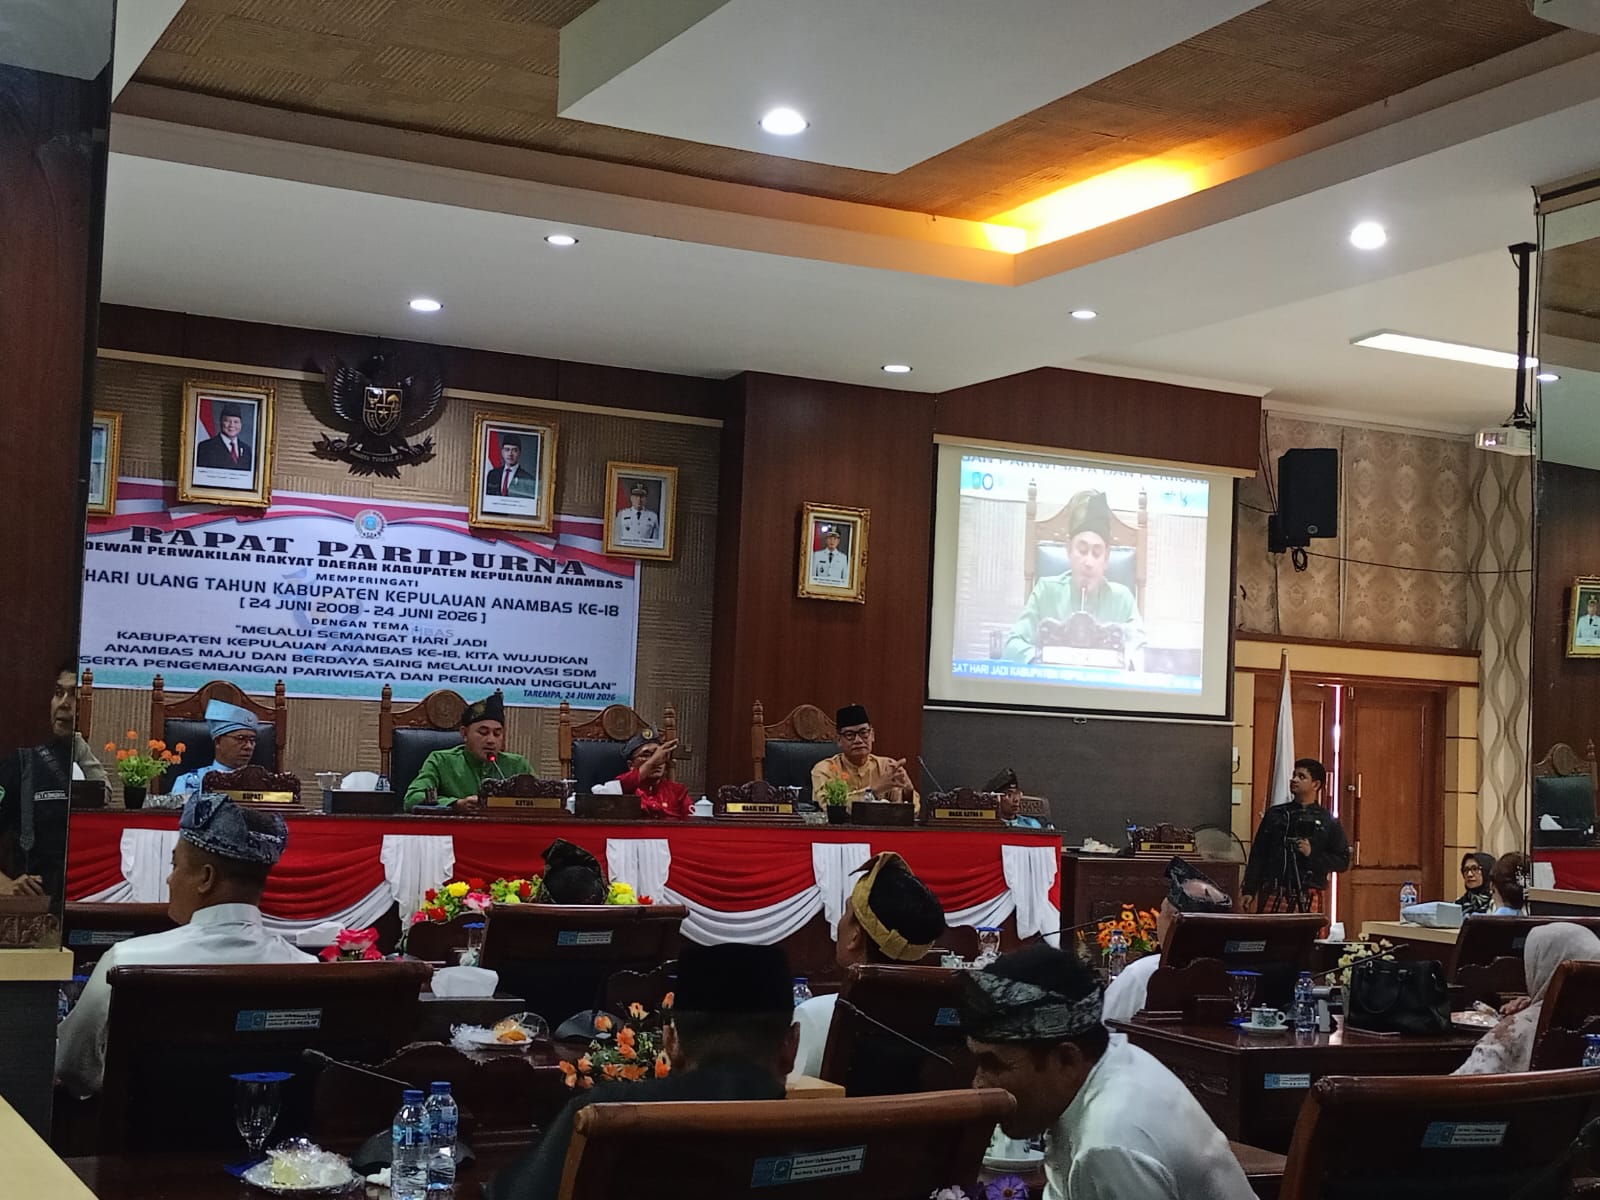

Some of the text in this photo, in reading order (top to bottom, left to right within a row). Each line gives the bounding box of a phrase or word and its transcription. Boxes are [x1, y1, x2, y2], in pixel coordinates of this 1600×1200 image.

[85, 541, 623, 589] DEWAN PERWAKILAN RAKYAT DAERAH KABUPATEN KEPULAUAN ANAMBAS
[130, 525, 586, 576] RAPAT PARIPURNA
[85, 569, 129, 584] HARI
[137, 572, 198, 588] ULANG
[205, 577, 266, 594] TAHUN
[273, 582, 379, 602] KABUPATEN
[385, 590, 486, 608] KEPULAUAN
[491, 598, 573, 614] ANAMBAS
[316, 573, 419, 587] MEMPERINGATI
[249, 598, 271, 609] 24
[275, 599, 312, 612] JUNI
[316, 603, 359, 615] 2008
[374, 606, 394, 618] 24
[399, 607, 433, 620] JUNI
[438, 610, 478, 623] 2026
[311, 618, 367, 629] DENGAN
[373, 622, 409, 631] TEMA
[117, 631, 221, 646] KABUPATEN
[226, 638, 326, 651] KEPULAUAN
[331, 644, 412, 656] ANAMBAS
[465, 651, 499, 661] KITA
[503, 653, 588, 665] WUJUDKAN
[317, 630, 407, 643] SEMANGAT
[412, 636, 448, 646] HARI
[453, 638, 487, 647] JADI
[80, 655, 138, 667] SERTA
[143, 659, 288, 674] PENGEMBANGAN
[292, 666, 396, 681] PARIWISATA
[400, 672, 434, 682] DAN
[438, 674, 526, 687] PERIKANAN
[104, 643, 597, 678] ANAMBAS MAJU DAN BERDAYA SAING MELALUI INOVASI SDM
